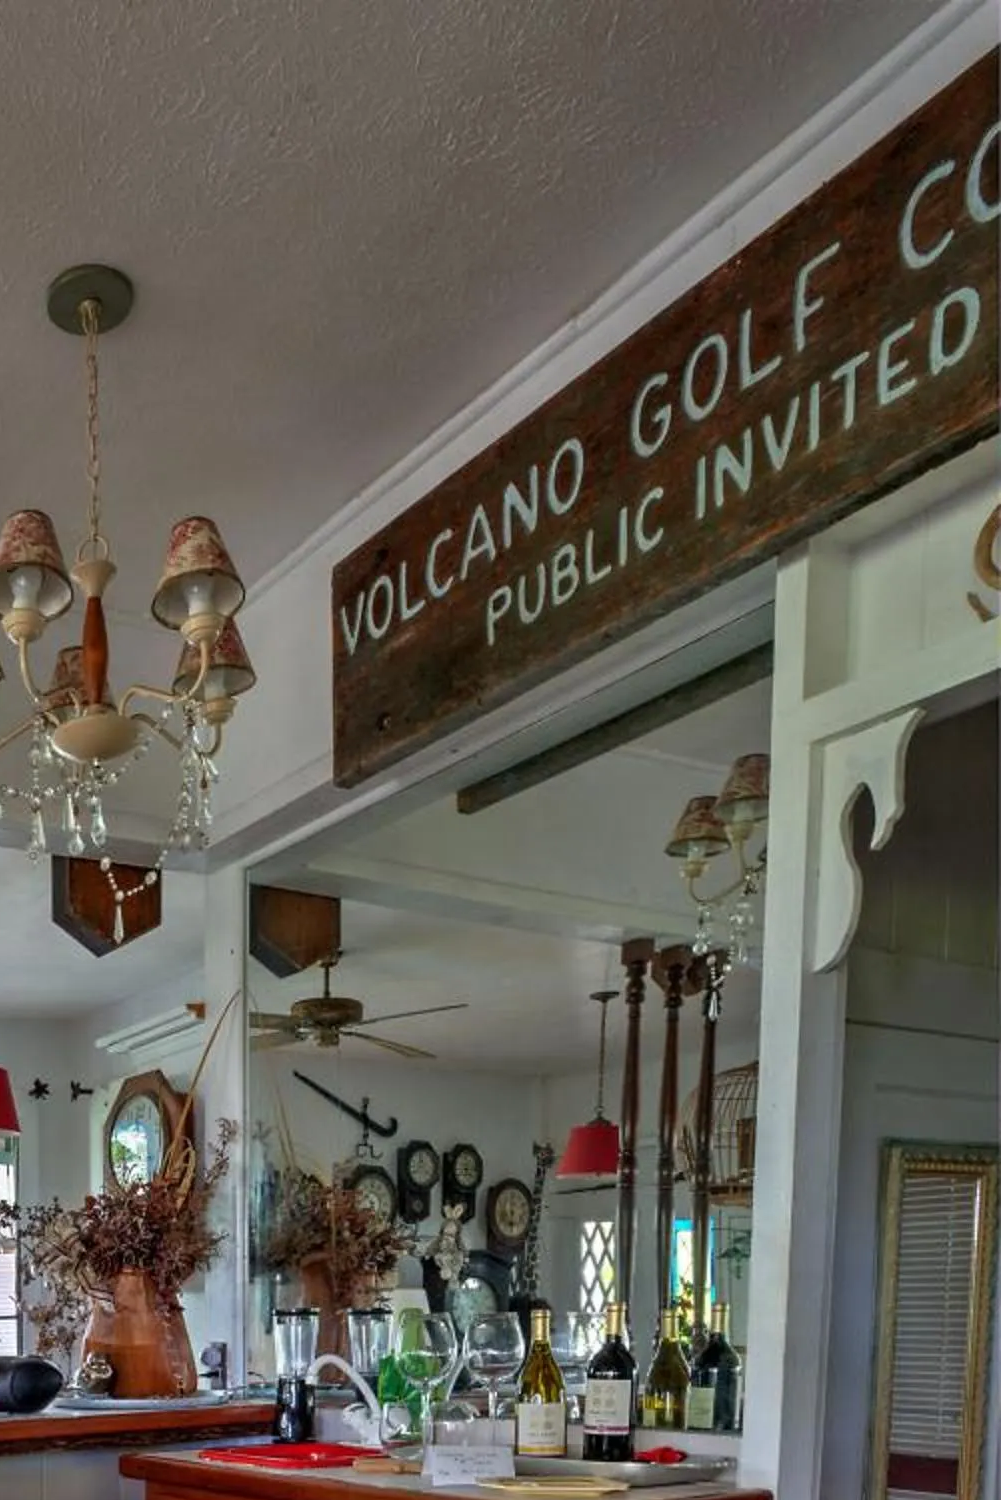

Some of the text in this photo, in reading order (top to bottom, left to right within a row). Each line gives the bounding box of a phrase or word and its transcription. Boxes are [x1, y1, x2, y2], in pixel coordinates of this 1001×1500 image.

[339, 437, 585, 656] VOLCANO
[630, 242, 841, 458] GOLF
[486, 287, 981, 646] PUBLIC INVITED
